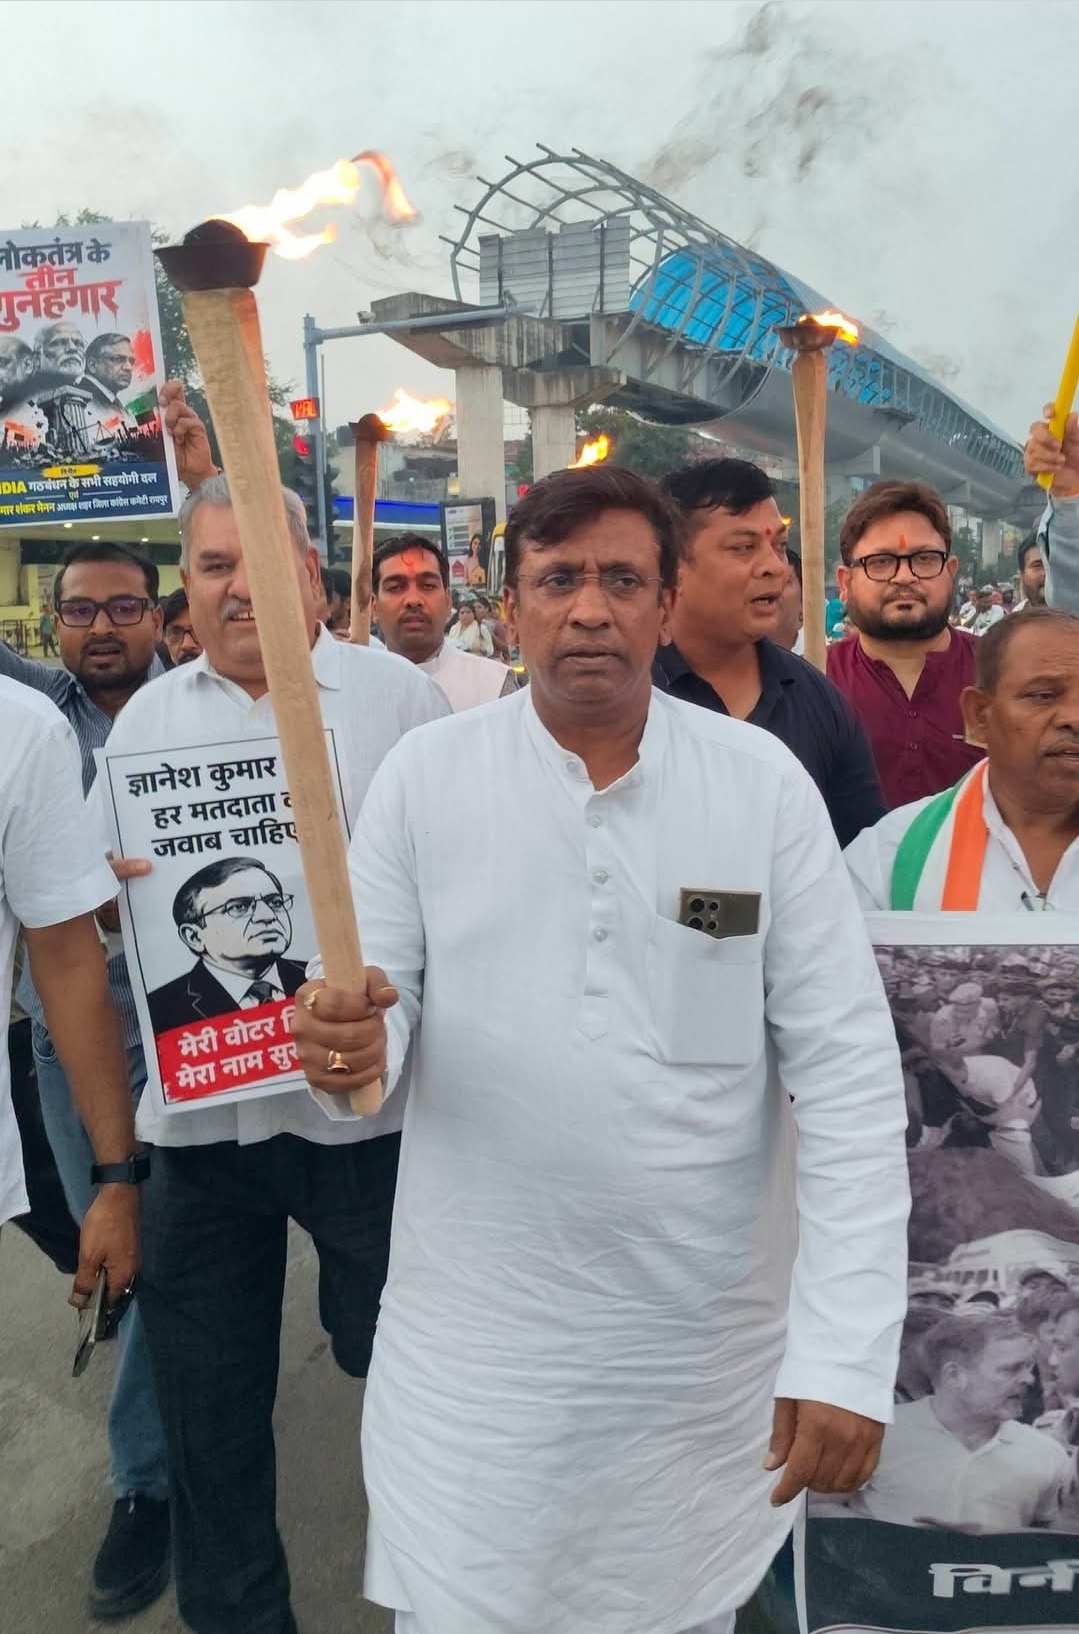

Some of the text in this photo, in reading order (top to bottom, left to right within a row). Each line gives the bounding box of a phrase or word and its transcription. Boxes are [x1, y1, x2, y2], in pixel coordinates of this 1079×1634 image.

[86, 238, 112, 263] के
[18, 264, 77, 289] तीन
[69, 477, 79, 488] के
[82, 476, 101, 488] सभी
[103, 471, 139, 486] सहयोगी
[126, 757, 276, 797] ज्ञानेश कुमार
[151, 806, 182, 829] हर
[188, 793, 276, 821] मतदाता
[151, 831, 222, 856] जवाब
[178, 1026, 218, 1057] मेरी
[222, 1018, 275, 1045] वोटर
[176, 1062, 215, 1088] मेरा
[220, 1050, 263, 1076] नाम
